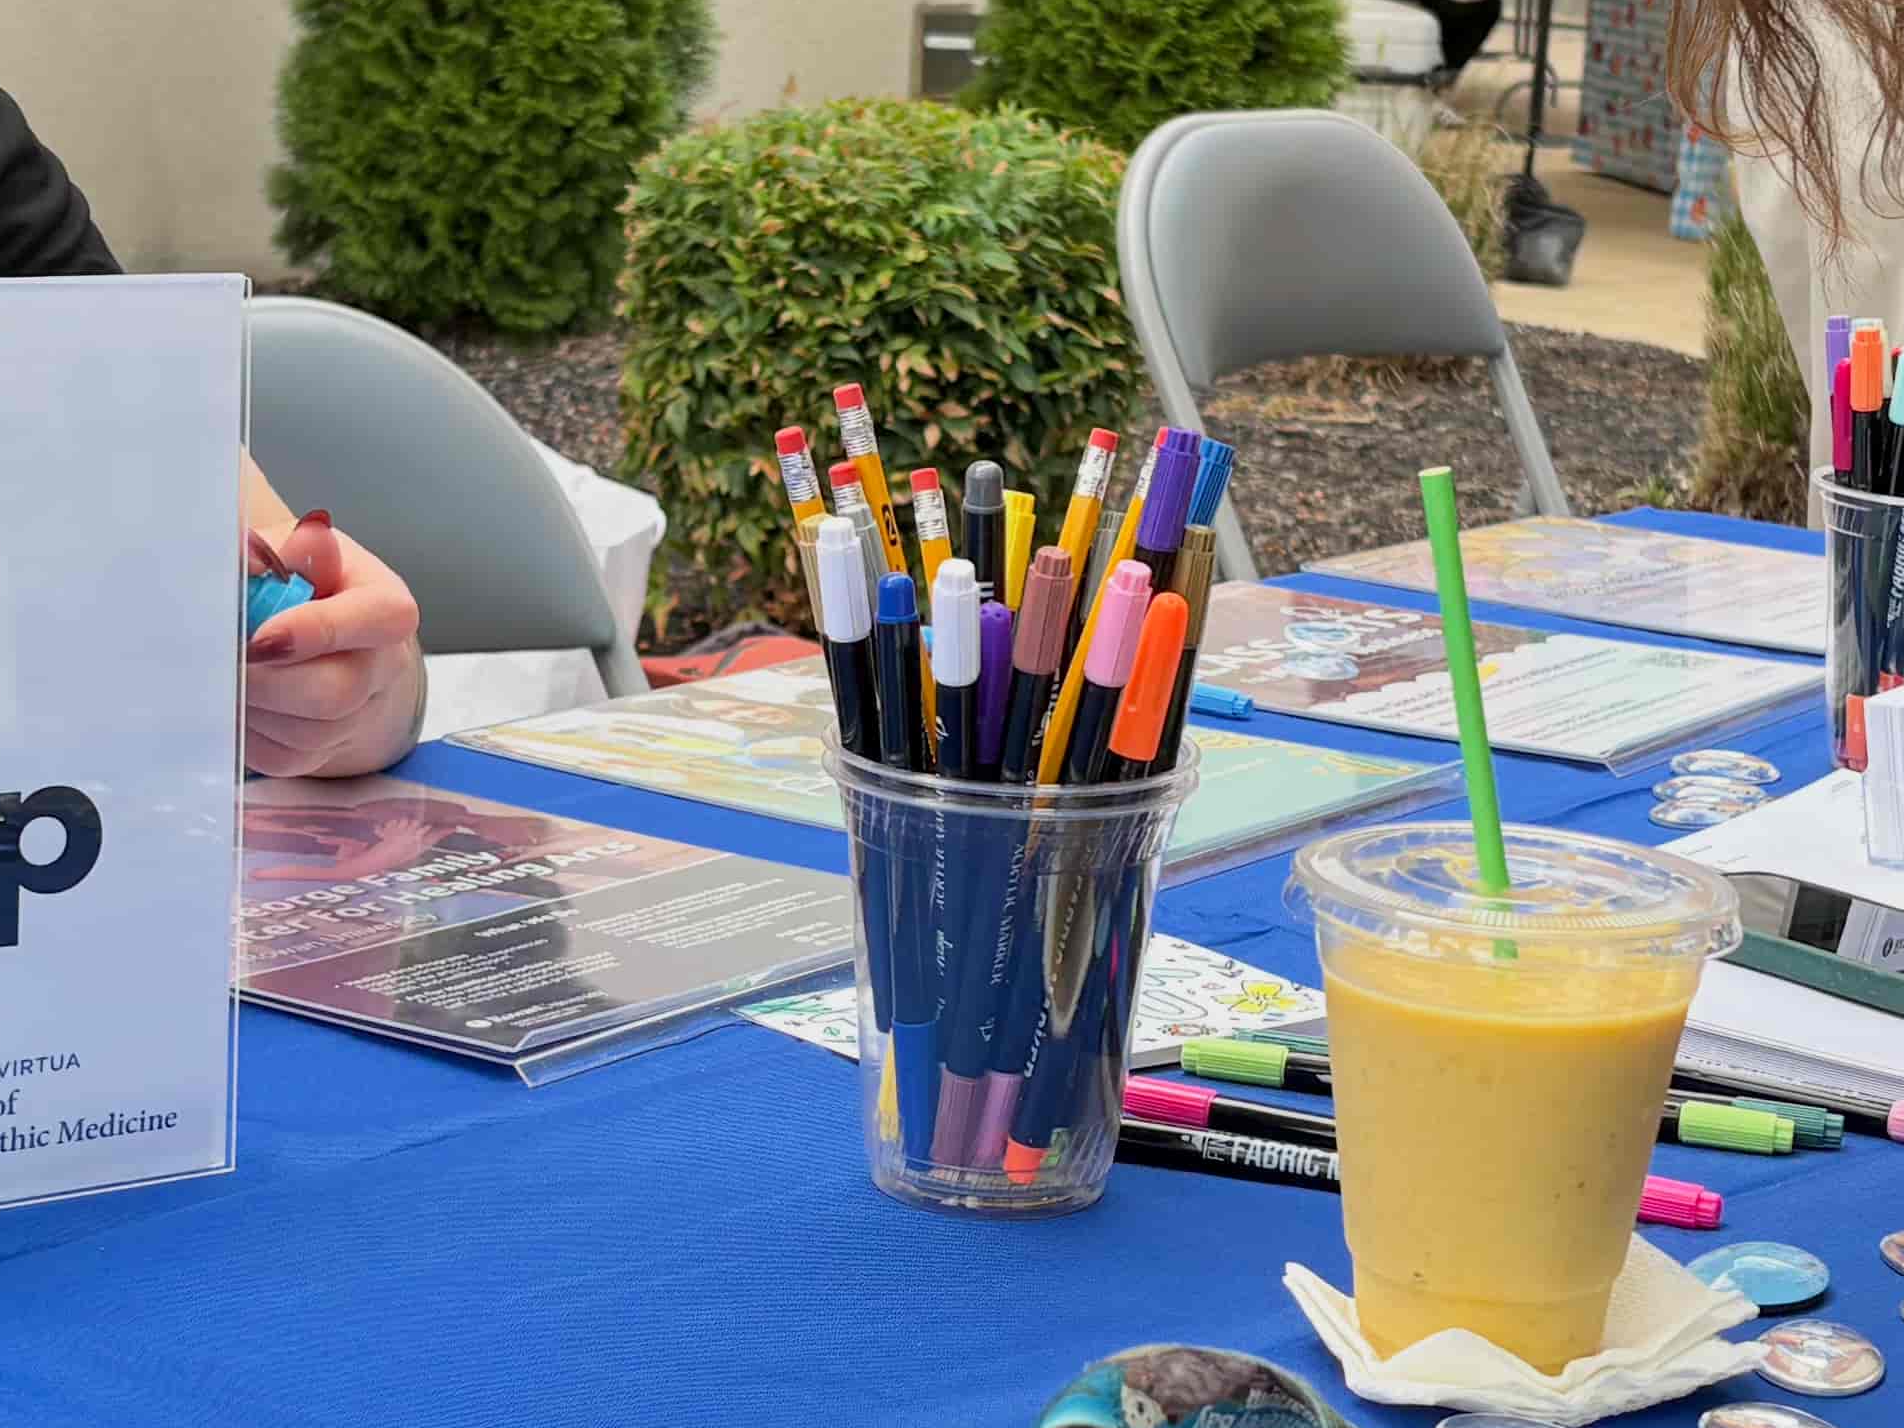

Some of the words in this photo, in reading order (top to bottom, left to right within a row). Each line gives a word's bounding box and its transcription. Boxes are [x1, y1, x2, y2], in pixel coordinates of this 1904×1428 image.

[236, 880, 366, 922] eorge
[356, 847, 503, 890] Family
[383, 861, 556, 909] Healing
[543, 839, 639, 868] Arts
[57, 1108, 178, 1145] Medicine
[1230, 1137, 1321, 1178] FABRIC
